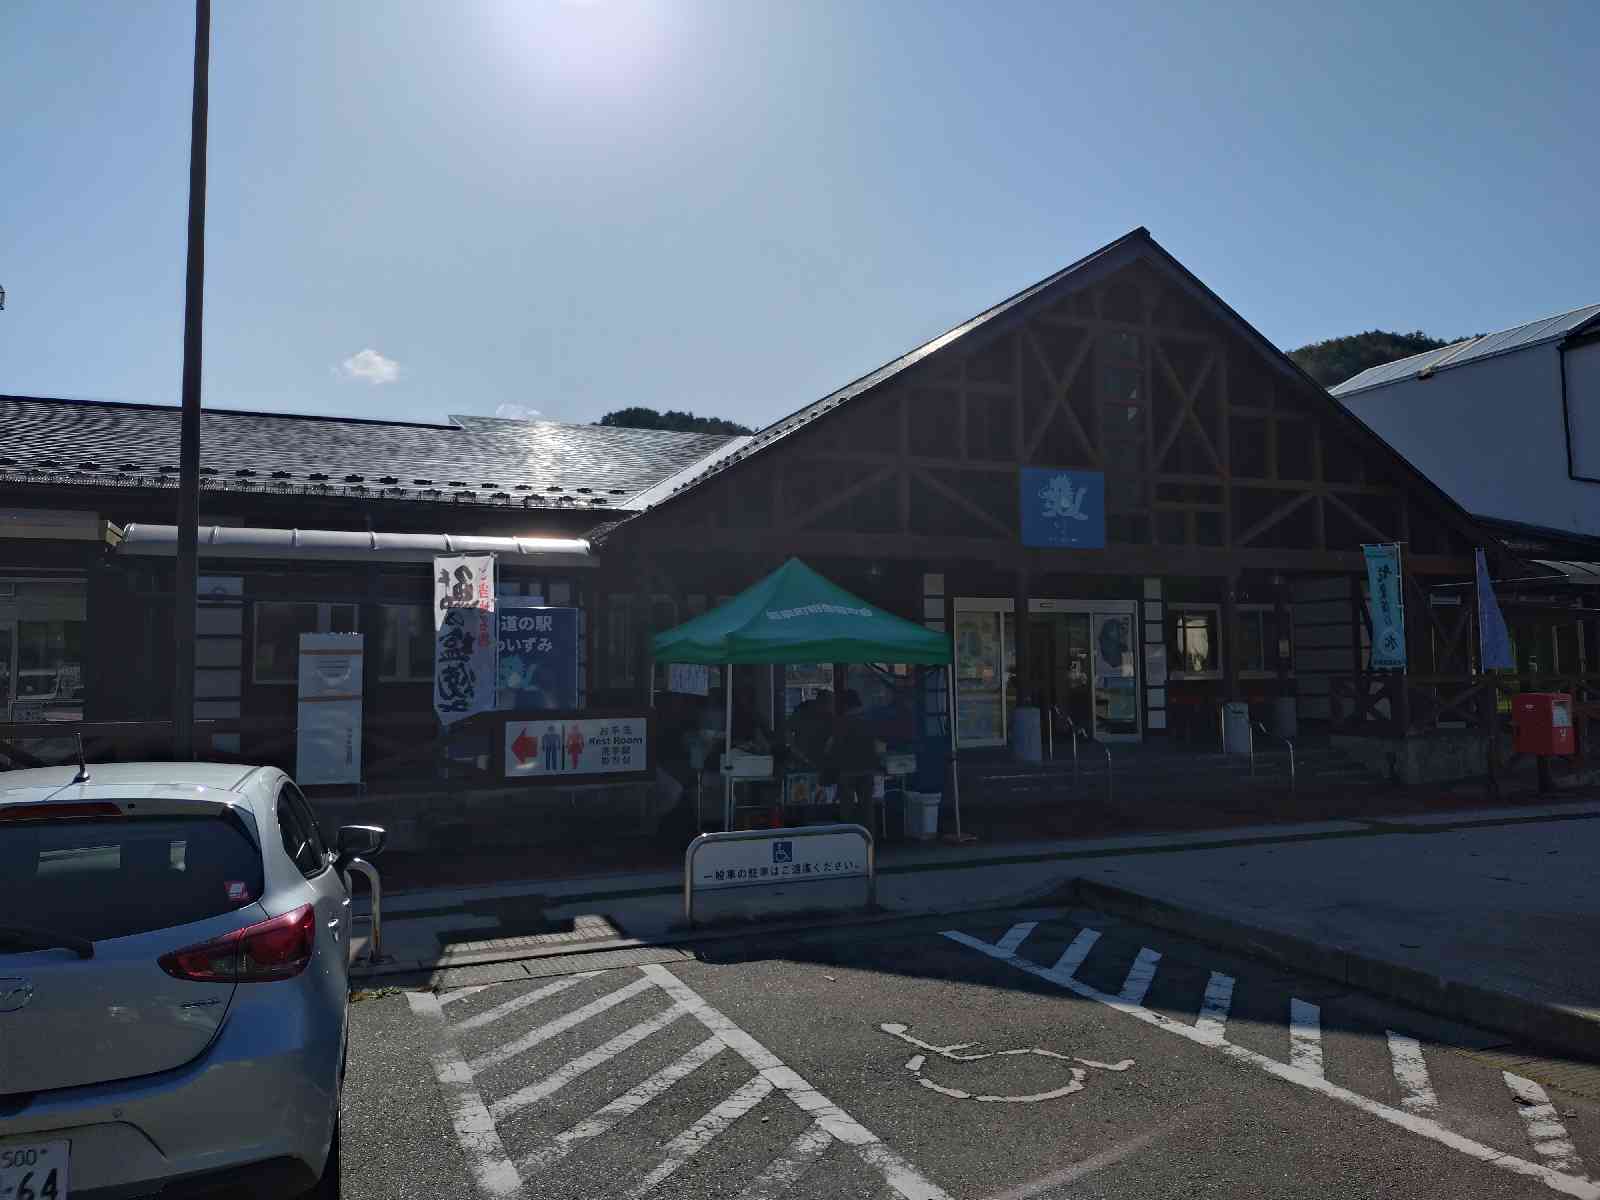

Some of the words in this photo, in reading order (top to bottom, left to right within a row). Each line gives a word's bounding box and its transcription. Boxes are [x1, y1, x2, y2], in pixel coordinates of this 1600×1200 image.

[501, 615, 553, 632] 道の駅
[613, 736, 643, 745] Room
